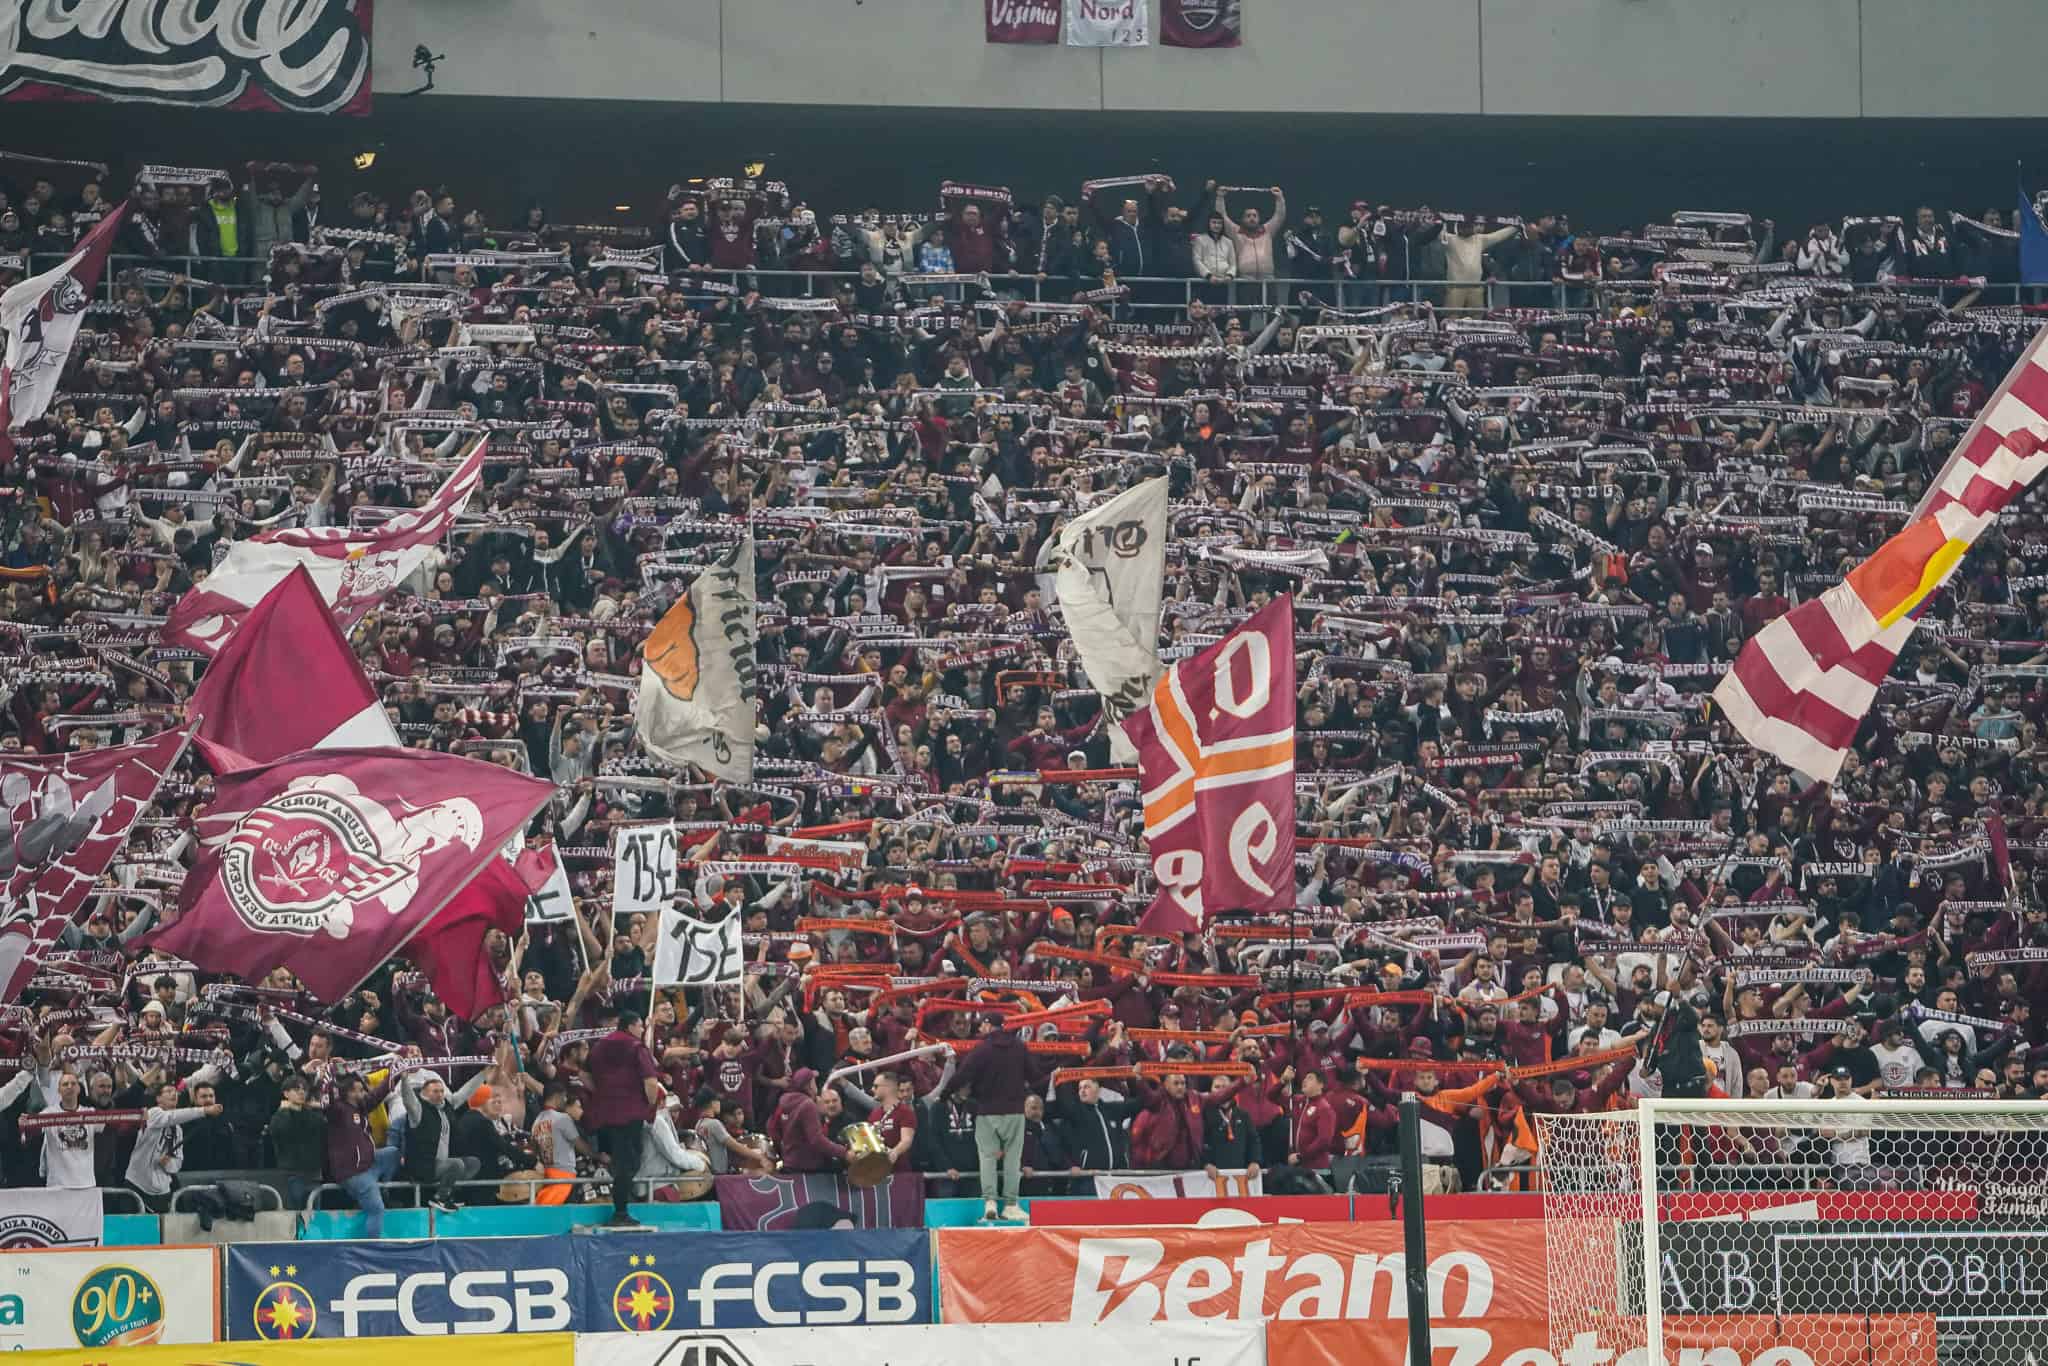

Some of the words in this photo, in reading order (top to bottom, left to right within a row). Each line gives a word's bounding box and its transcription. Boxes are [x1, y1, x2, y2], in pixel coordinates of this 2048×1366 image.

[1080, 0, 1135, 20] Nord
[455, 255, 496, 265] RAPID
[1108, 322, 1149, 335] FORZA
[1153, 322, 1192, 336] RAPID
[1664, 663, 1711, 677] RAPID
[1937, 734, 1990, 749] RAPID
[1443, 757, 1482, 768] RAPID
[1486, 755, 1515, 766] 1923
[755, 785, 792, 797] APID
[822, 785, 843, 797] 19
[871, 785, 893, 797] 23
[1815, 862, 1866, 875] RAPID
[112, 1045, 158, 1061] RAPID
[0, 1219, 27, 1232] LUZA
[31, 1220, 61, 1240] NORD
[1070, 1237, 1494, 1321] Betano
[1853, 1254, 2048, 1297] IMOBIL
[688, 1259, 917, 1326] FCSB
[330, 1267, 571, 1336] FCSB
